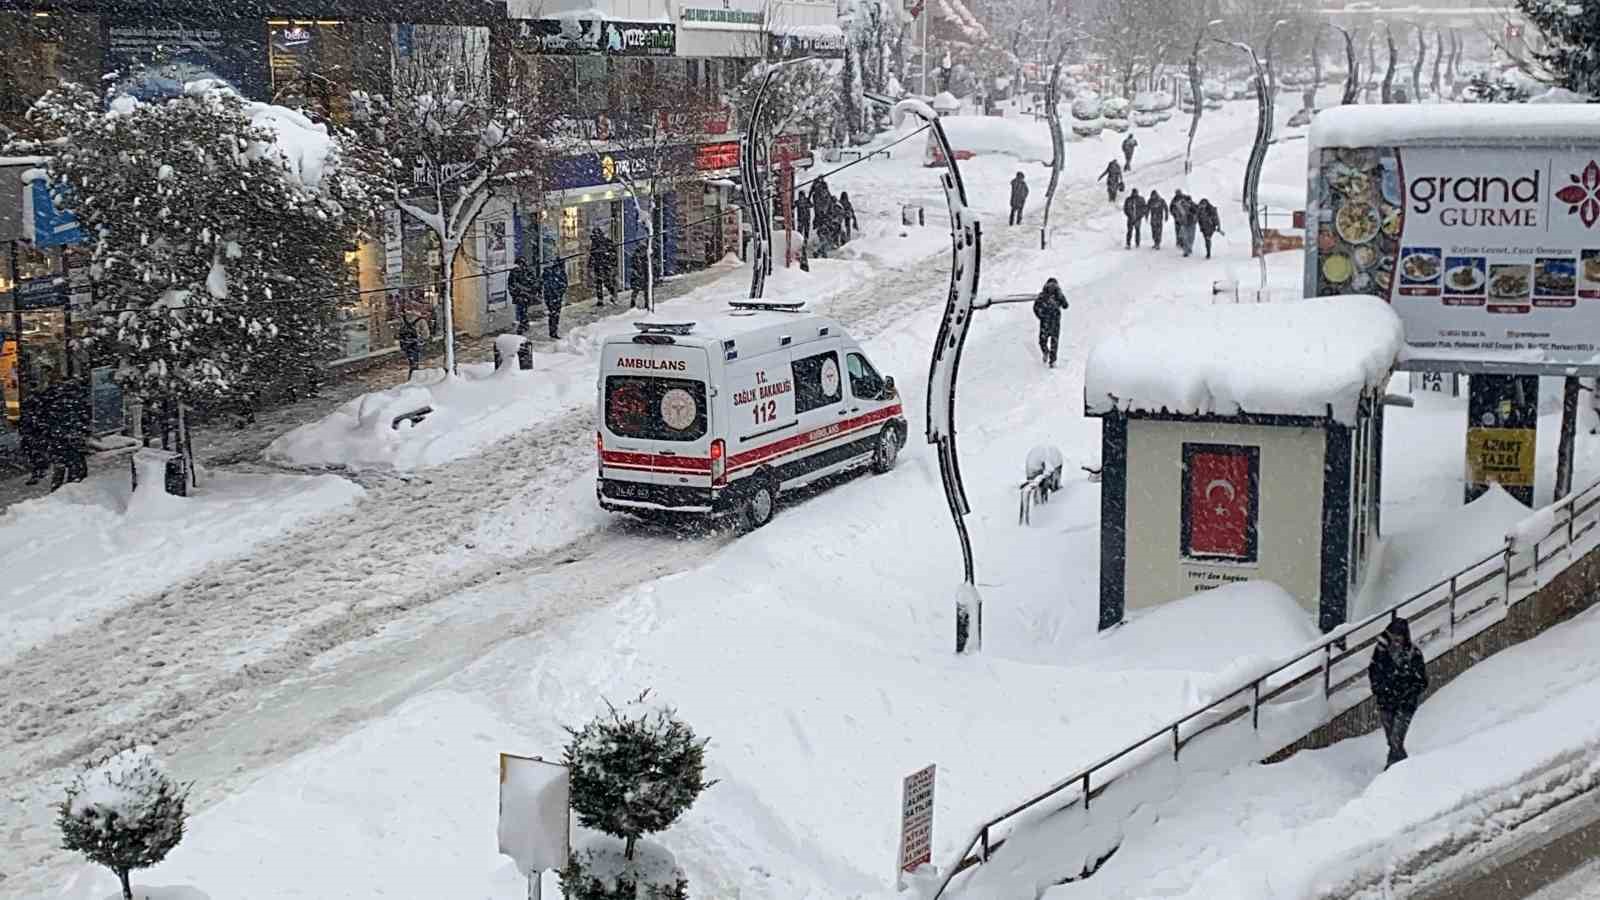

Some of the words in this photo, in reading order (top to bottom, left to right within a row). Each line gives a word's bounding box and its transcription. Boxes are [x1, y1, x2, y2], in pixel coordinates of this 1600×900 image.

[1410, 169, 1540, 214] grand
[1440, 208, 1537, 227] GURME
[617, 357, 687, 371] AMBULANS
[756, 371, 769, 385] T.C.
[733, 388, 757, 406] SAĞLIK
[759, 379, 793, 399] BAKANLIĞI
[753, 400, 777, 425] 112
[809, 424, 841, 441] AMBULANS
